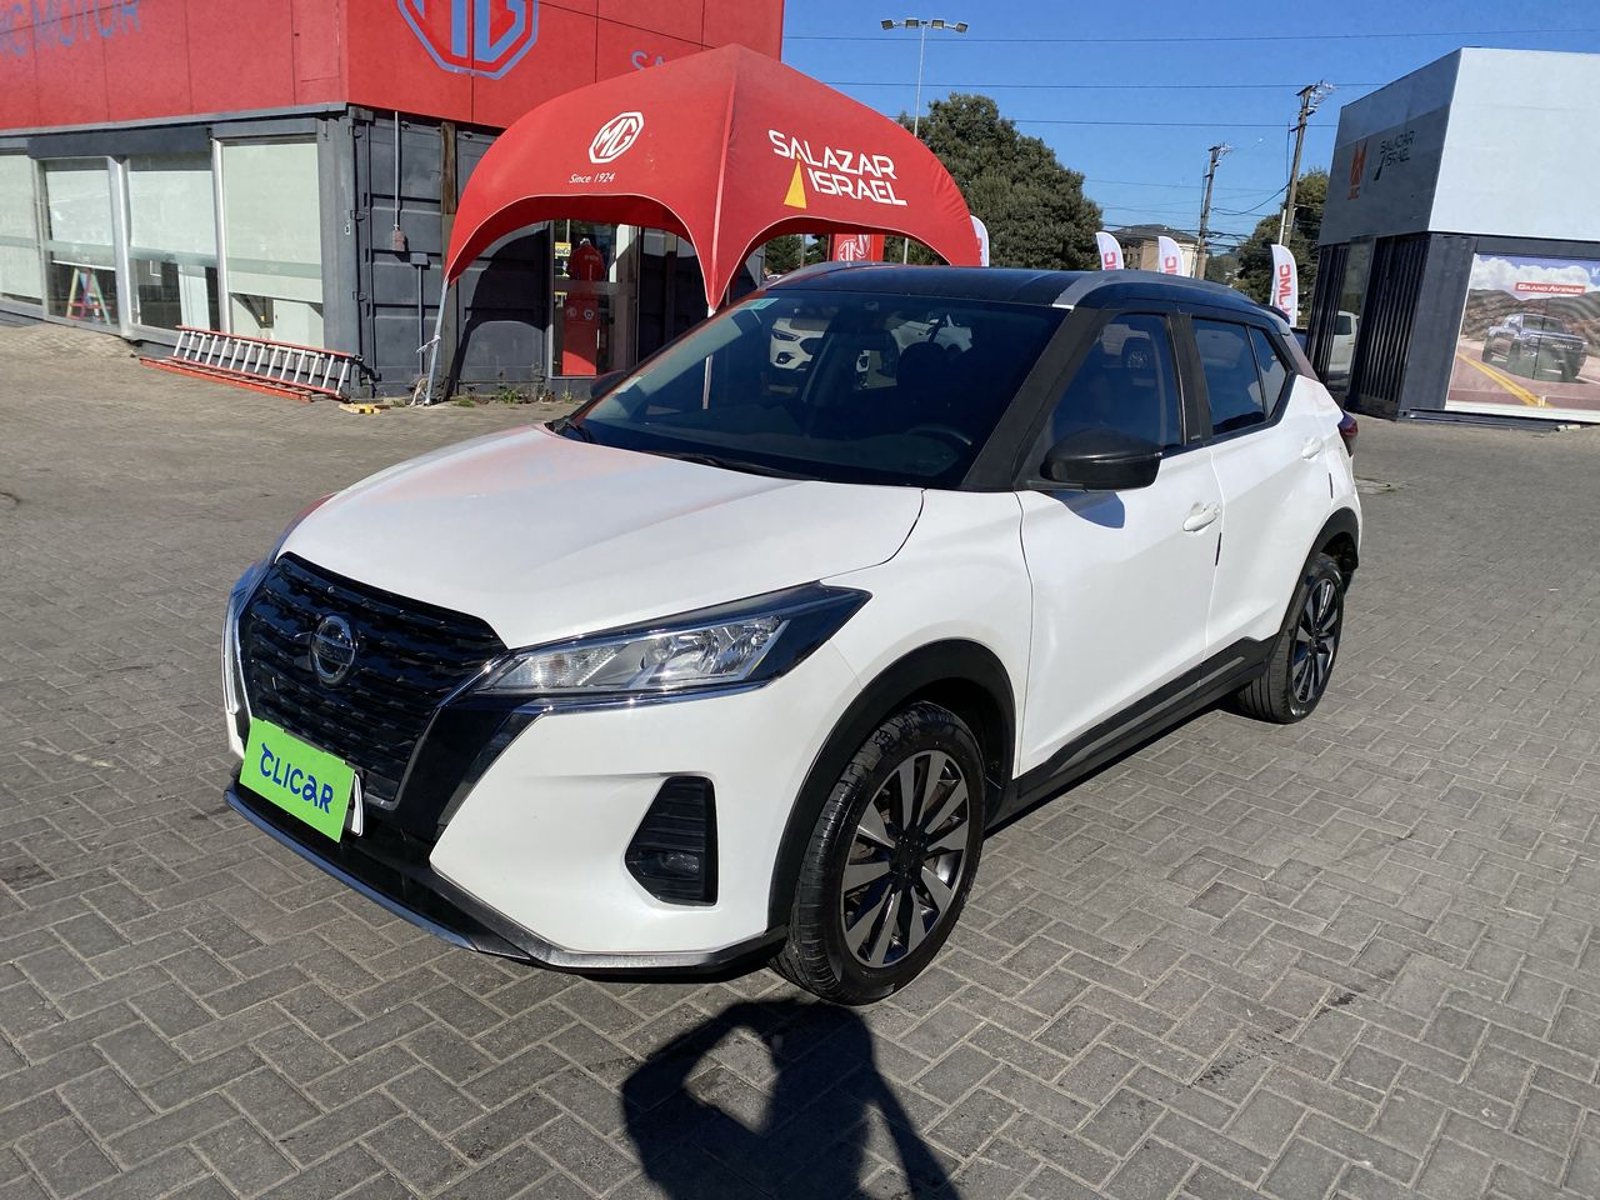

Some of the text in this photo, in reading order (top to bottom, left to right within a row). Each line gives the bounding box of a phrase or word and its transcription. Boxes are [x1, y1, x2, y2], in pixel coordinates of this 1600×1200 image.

[592, 115, 641, 160] MG
[768, 129, 898, 180] SALAZAR
[569, 172, 616, 184] Since 1924
[807, 167, 908, 206] ISRAEL
